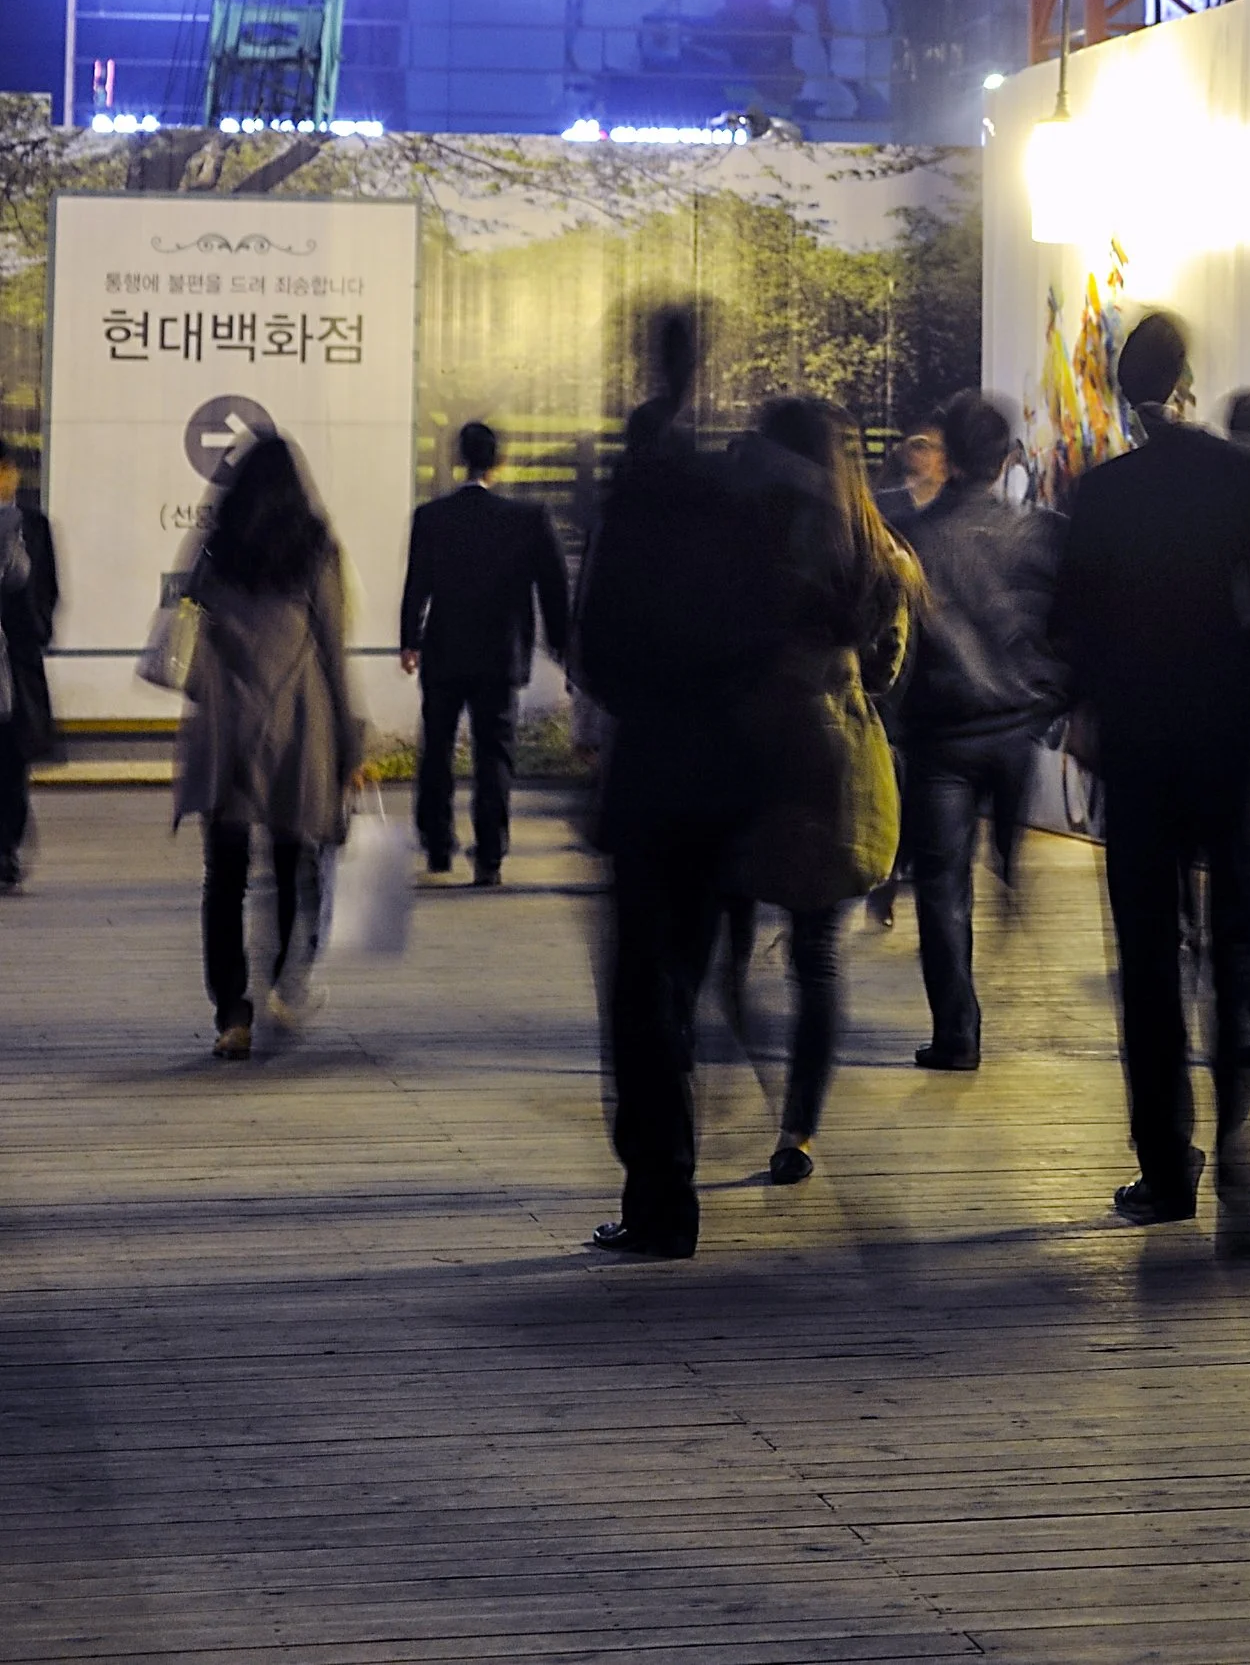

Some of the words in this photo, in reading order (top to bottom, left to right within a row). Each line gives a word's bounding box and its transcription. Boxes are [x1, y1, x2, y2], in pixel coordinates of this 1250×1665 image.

[105, 271, 159, 294] 통행에
[168, 272, 221, 295] 불편을
[229, 274, 266, 296] 드려
[274, 275, 365, 298] 죄송합니다
[102, 309, 363, 363] 현대백화점
